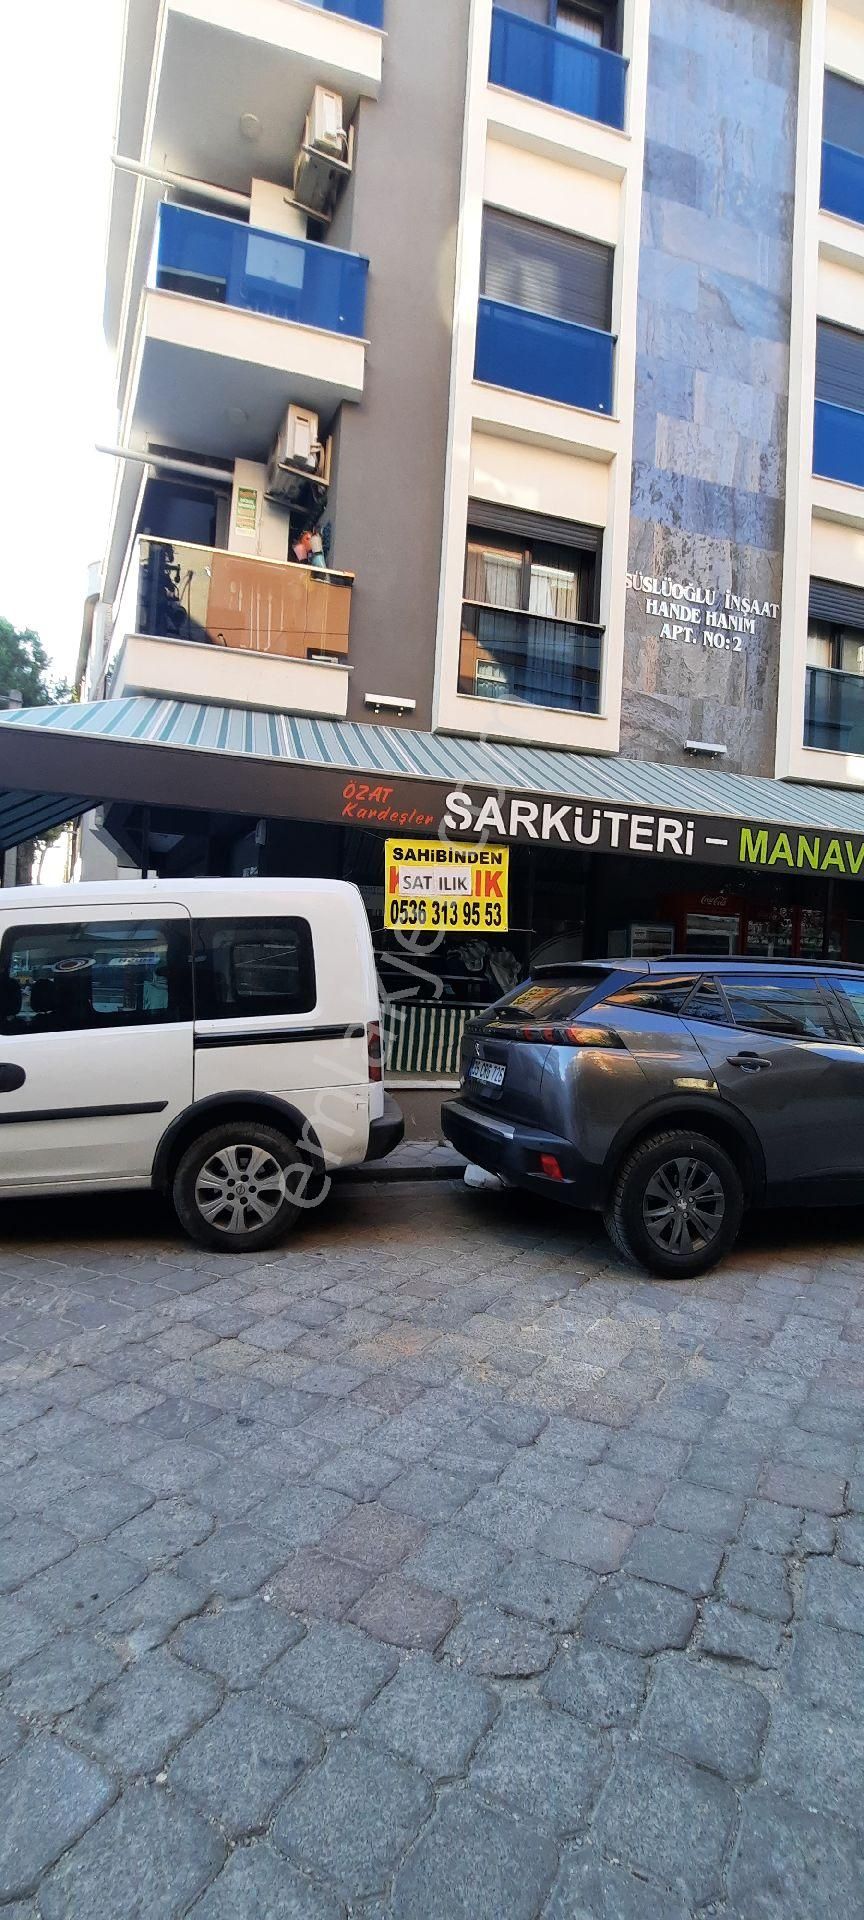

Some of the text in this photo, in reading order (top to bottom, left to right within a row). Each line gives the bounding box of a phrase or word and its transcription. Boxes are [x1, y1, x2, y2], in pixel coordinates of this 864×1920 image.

[645, 598, 756, 635] HANDE HANIM
[724, 589, 780, 619] İNŞAAT
[659, 623, 697, 644] APT.
[341, 779, 394, 804] ÖZAT
[341, 801, 434, 827] Kardeşler
[739, 827, 864, 874] MANAV
[390, 899, 502, 927] 0536 313 95 53
